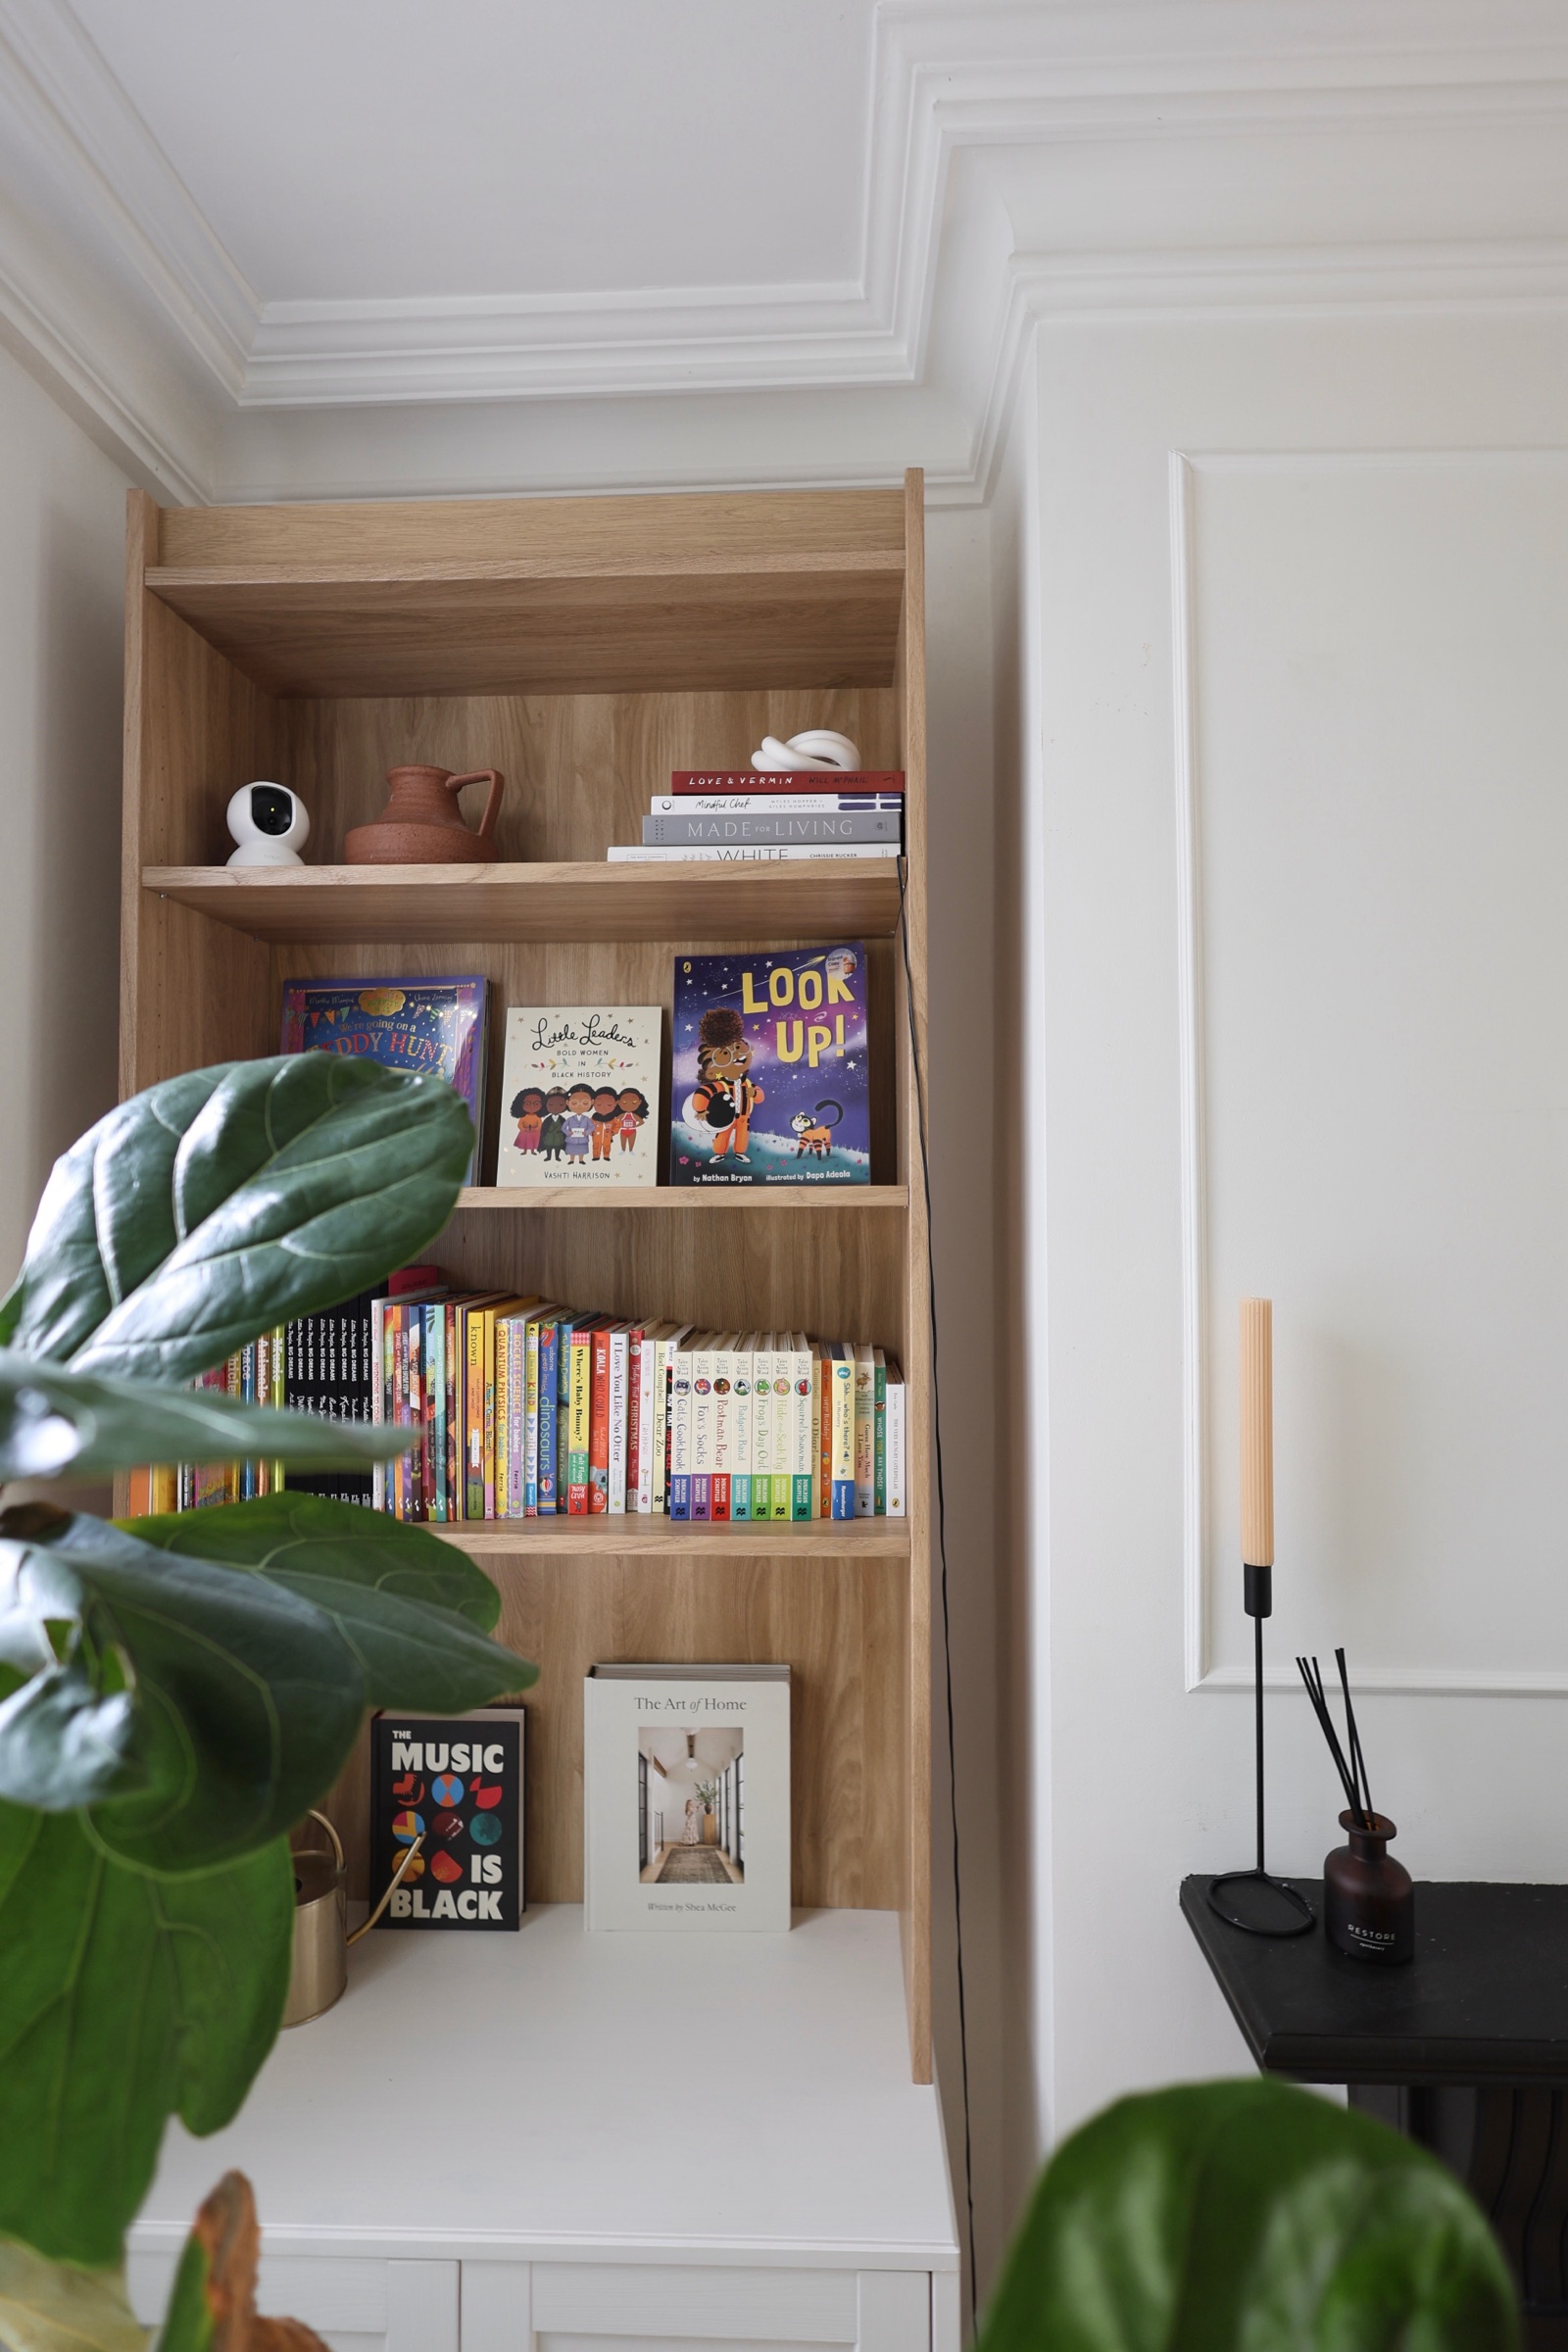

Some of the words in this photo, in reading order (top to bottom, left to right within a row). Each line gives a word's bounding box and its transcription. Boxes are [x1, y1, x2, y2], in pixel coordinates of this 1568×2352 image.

[808, 775, 828, 784] WILL
[695, 799, 727, 811] Mindful
[729, 798, 751, 809] Chef
[688, 821, 751, 837] MADE
[775, 819, 853, 836] LIVING
[742, 967, 855, 1014] LOOK
[337, 1021, 365, 1032] We're
[367, 1019, 394, 1032] going
[396, 1021, 409, 1030] on
[409, 1023, 416, 1032] a
[530, 1017, 578, 1051] Little
[579, 1013, 637, 1048] Leaders
[389, 1032, 454, 1066] HUNT
[776, 1014, 845, 1068] UP!
[806, 1171, 824, 1181] Dapo
[826, 1170, 851, 1179] Adeola
[470, 1326, 481, 1366] known
[498, 1330, 506, 1379] QUANTUM
[513, 1334, 521, 1370] ROCKET
[558, 1345, 569, 1367] Wonky
[257, 1339, 269, 1398] Animals
[272, 1338, 283, 1383] Music
[540, 1353, 548, 1371] peep
[596, 1348, 606, 1374] KOALA
[614, 1348, 622, 1371] Love
[540, 1374, 549, 1394] inside
[558, 1368, 569, 1394] Donkey
[595, 1376, 605, 1392] WHO
[614, 1374, 622, 1392] You
[631, 1364, 639, 1385] Baby's
[656, 1368, 664, 1403] Campbell
[498, 1382, 506, 1420] PHYSICS
[513, 1374, 521, 1413] SCIENCE
[528, 1382, 536, 1406] KIND
[574, 1386, 583, 1406] Baby
[631, 1386, 639, 1398] First
[595, 1394, 605, 1418] COULD
[614, 1395, 622, 1416] Like
[676, 1399, 687, 1421] Cat's
[756, 1399, 768, 1426] Frog's
[778, 1400, 787, 1420] Hide
[797, 1398, 808, 1432] Squirrel's
[498, 1424, 506, 1435] for
[513, 1416, 521, 1428] for
[573, 1409, 583, 1441] Bunny?
[613, 1419, 622, 1433] No
[630, 1400, 638, 1450] CHRISTMAS
[656, 1413, 664, 1436] Dear
[697, 1406, 708, 1430] Fox's
[716, 1399, 728, 1441] Postman
[737, 1405, 747, 1437] Badger's
[513, 1429, 521, 1453] babies
[539, 1396, 555, 1470] dinosaurs
[756, 1430, 768, 1447] Day
[778, 1434, 787, 1454] Seek
[498, 1436, 506, 1460] babies
[613, 1435, 622, 1462] Otter
[656, 1440, 664, 1456] Zoo
[676, 1424, 687, 1471] Cookbook
[697, 1434, 708, 1465] Socks
[716, 1444, 728, 1468] Bear
[738, 1440, 747, 1461] Band
[799, 1434, 808, 1473] Snowman
[758, 1450, 769, 1470] Out
[774, 1457, 786, 1470] Pig
[576, 1467, 584, 1484] Flaps
[633, 1696, 662, 1710] The
[664, 1697, 686, 1710] Art
[689, 1697, 704, 1713] of
[704, 1697, 747, 1710] Home
[392, 1730, 412, 1740] THE
[391, 1741, 505, 1773] MUSIC
[470, 1854, 503, 1885] IS
[390, 1888, 504, 1921] BLACK
[675, 1903, 683, 1912] by
